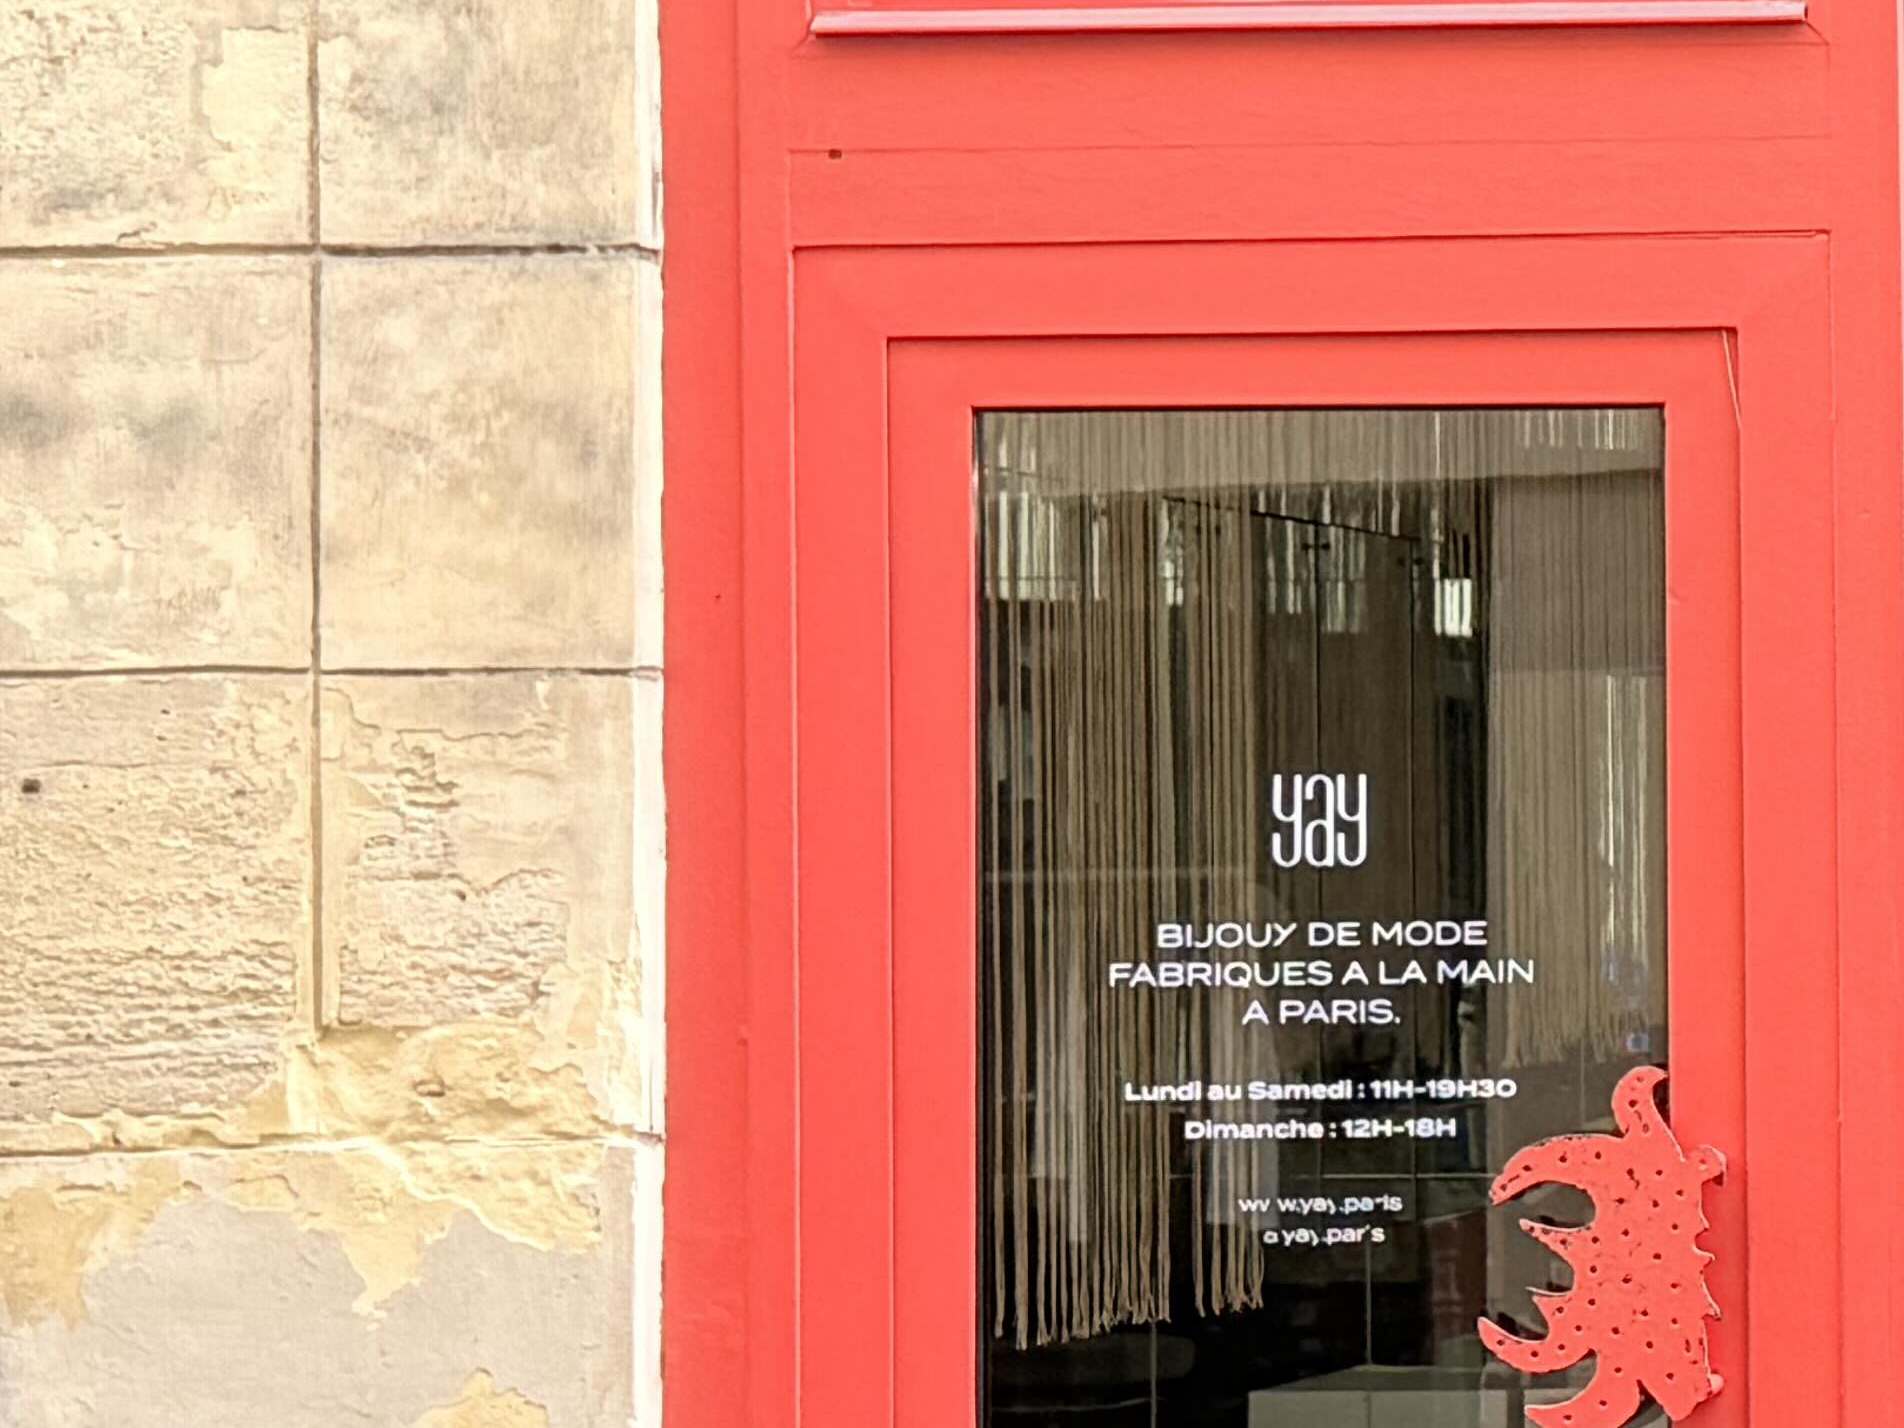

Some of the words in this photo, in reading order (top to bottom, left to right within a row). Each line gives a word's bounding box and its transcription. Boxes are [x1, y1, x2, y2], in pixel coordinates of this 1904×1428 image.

[1271, 773, 1368, 869] yay
[1308, 922, 1361, 947] DE
[1372, 920, 1488, 946] MODE
[1109, 960, 1334, 988] FABRIQUES
[1341, 961, 1369, 985] A
[1379, 960, 1428, 986] LA
[1437, 958, 1535, 984] MAIN
[1242, 999, 1270, 1025] A
[1279, 998, 1402, 1025] PARIS.
[1124, 1079, 1202, 1101] Lundi
[1207, 1083, 1242, 1101] au
[1247, 1079, 1354, 1101] Samedi
[1370, 1078, 1518, 1099] 11H-19H30
[1185, 1118, 1325, 1141] Dimanche
[1341, 1117, 1457, 1139] 12H-18H
